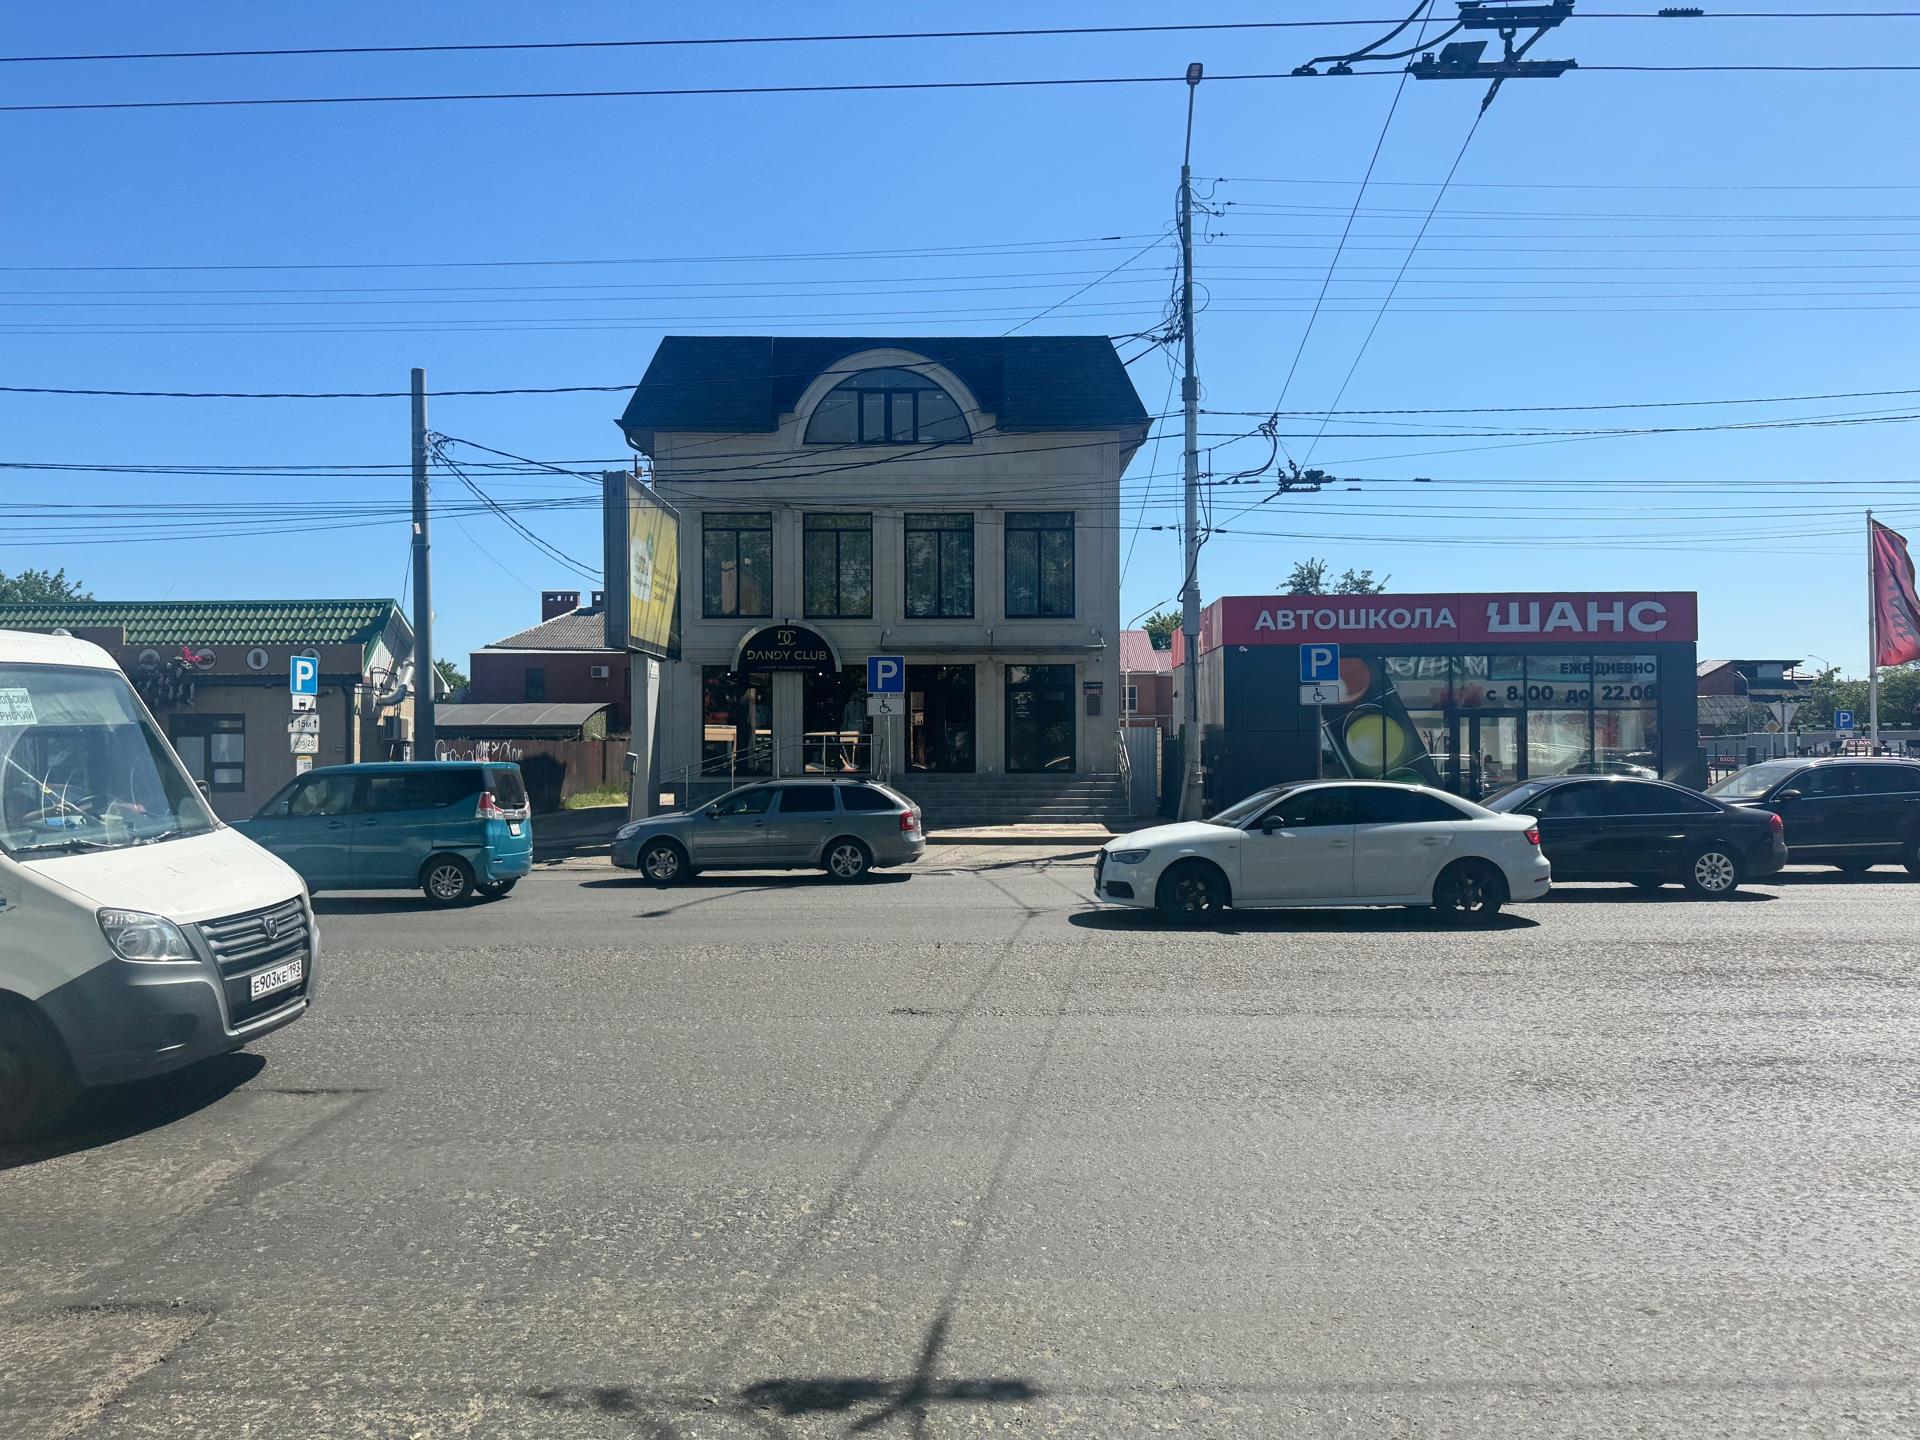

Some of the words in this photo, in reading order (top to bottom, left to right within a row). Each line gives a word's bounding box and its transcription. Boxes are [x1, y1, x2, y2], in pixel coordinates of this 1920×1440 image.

[1254, 607, 1456, 631] АВТОШКОЛА
[1486, 601, 1668, 633] ШАНС
[746, 650, 791, 660] DANDY
[794, 650, 827, 660] CLUB
[1311, 648, 1333, 678] P
[296, 660, 314, 691] P
[877, 660, 898, 689] P
[1559, 661, 1656, 677] ЕЖЕДНЕВНО
[1486, 689, 1497, 702] с
[1506, 685, 1555, 702] 8.00
[1565, 689, 1591, 704] до
[1601, 685, 1656, 702] 22.00
[1839, 712, 1851, 727] P
